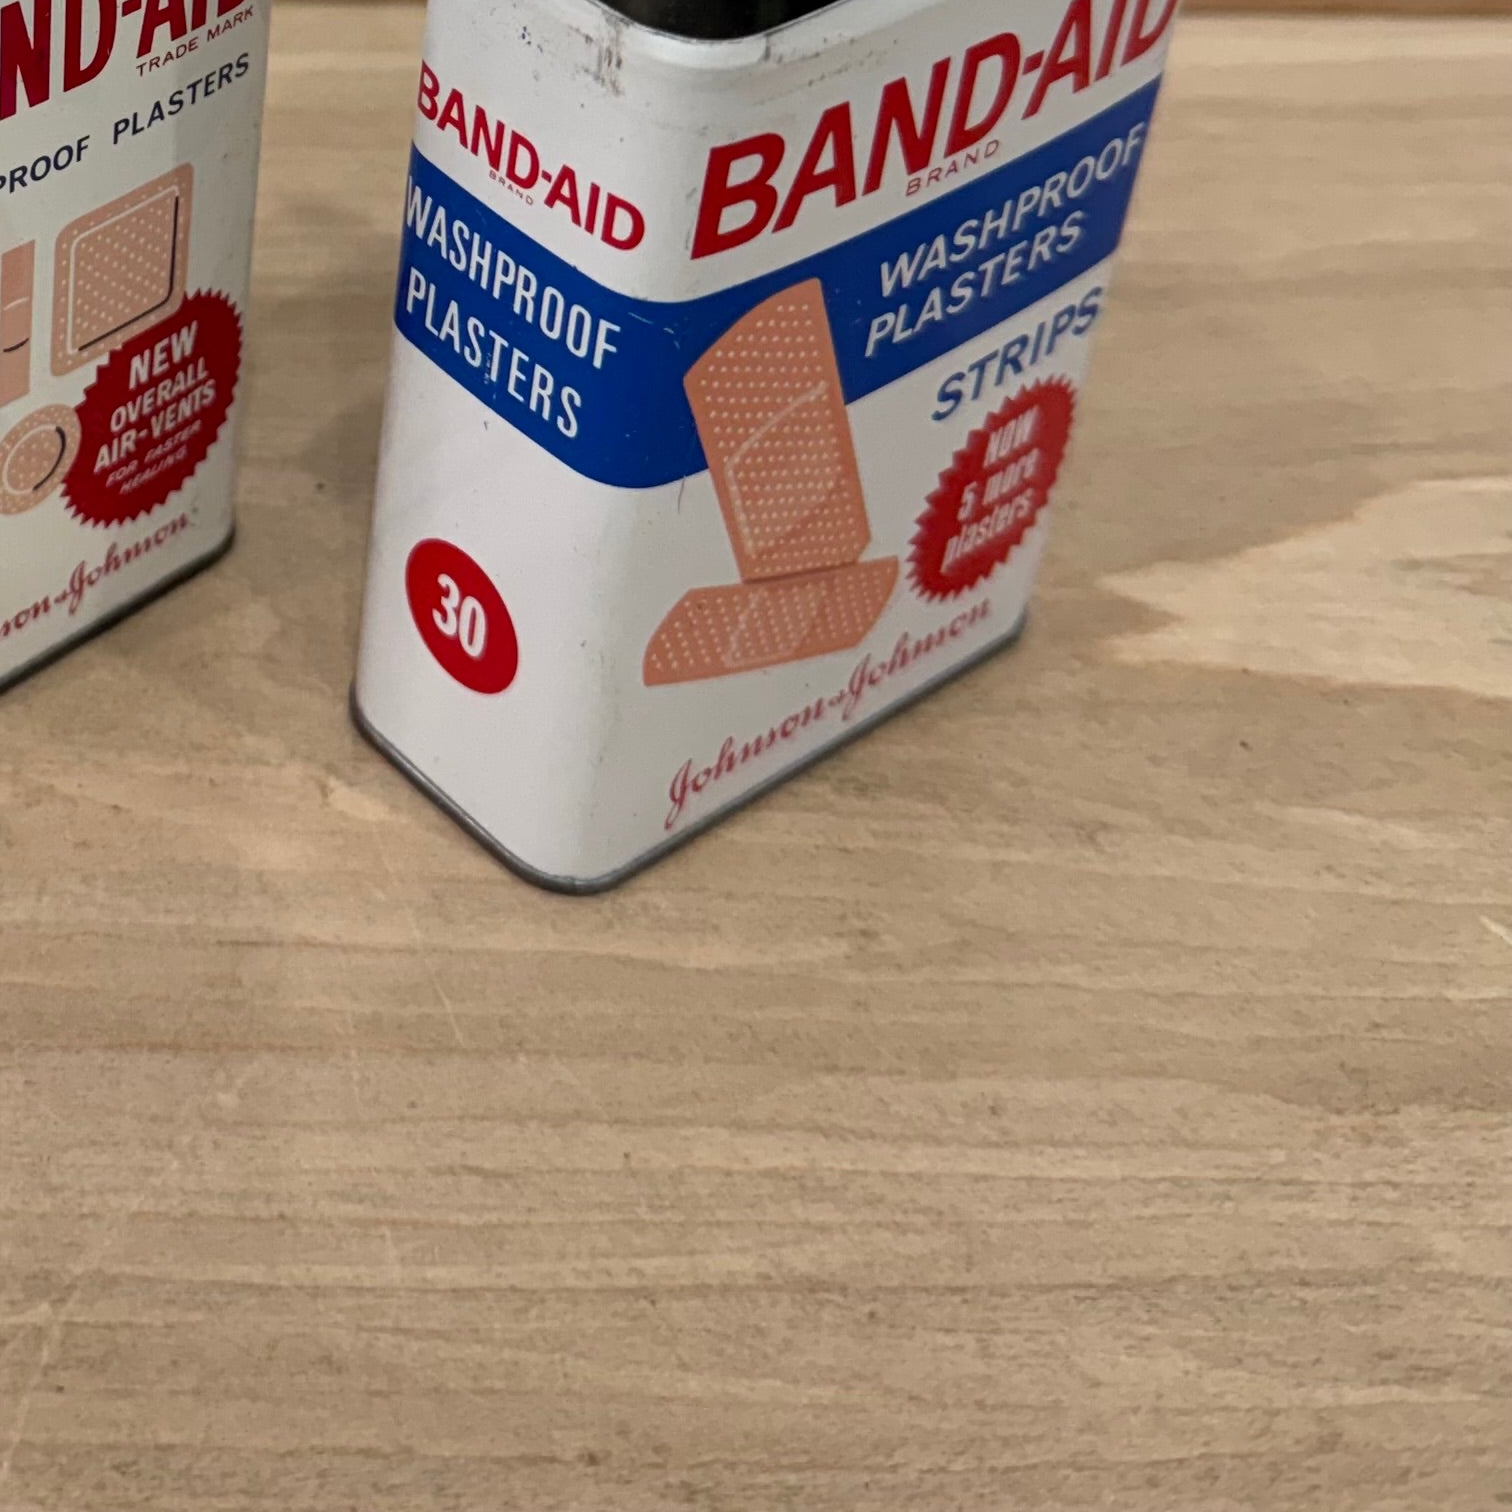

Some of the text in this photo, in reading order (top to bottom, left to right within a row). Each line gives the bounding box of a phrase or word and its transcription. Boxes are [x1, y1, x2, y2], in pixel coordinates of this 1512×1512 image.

[137, 5, 255, 78] TRADE MARK
[112, 53, 250, 145] PLASTERS
[416, 59, 645, 252] BAND-AID
[489, 170, 535, 206] BRAND
[905, 139, 1000, 197] BRAND
[879, 122, 1146, 299] WASHPROOF
[405, 175, 621, 370] WASHPROOF
[864, 210, 1085, 358] PLASTERS
[110, 356, 209, 433] OVERALL
[129, 319, 198, 391] NEW
[406, 266, 583, 439] PLASTERS
[931, 286, 1104, 422] STRIPS
[93, 378, 217, 474] AIR-VENTS
[105, 418, 202, 488] FOR FASTER
[119, 444, 187, 496] HEALING
[957, 481, 979, 522] 5
[67, 512, 188, 616] Johnson
[432, 573, 486, 658] 30
[663, 698, 824, 831] Johnson
[841, 598, 991, 721] Johnson
